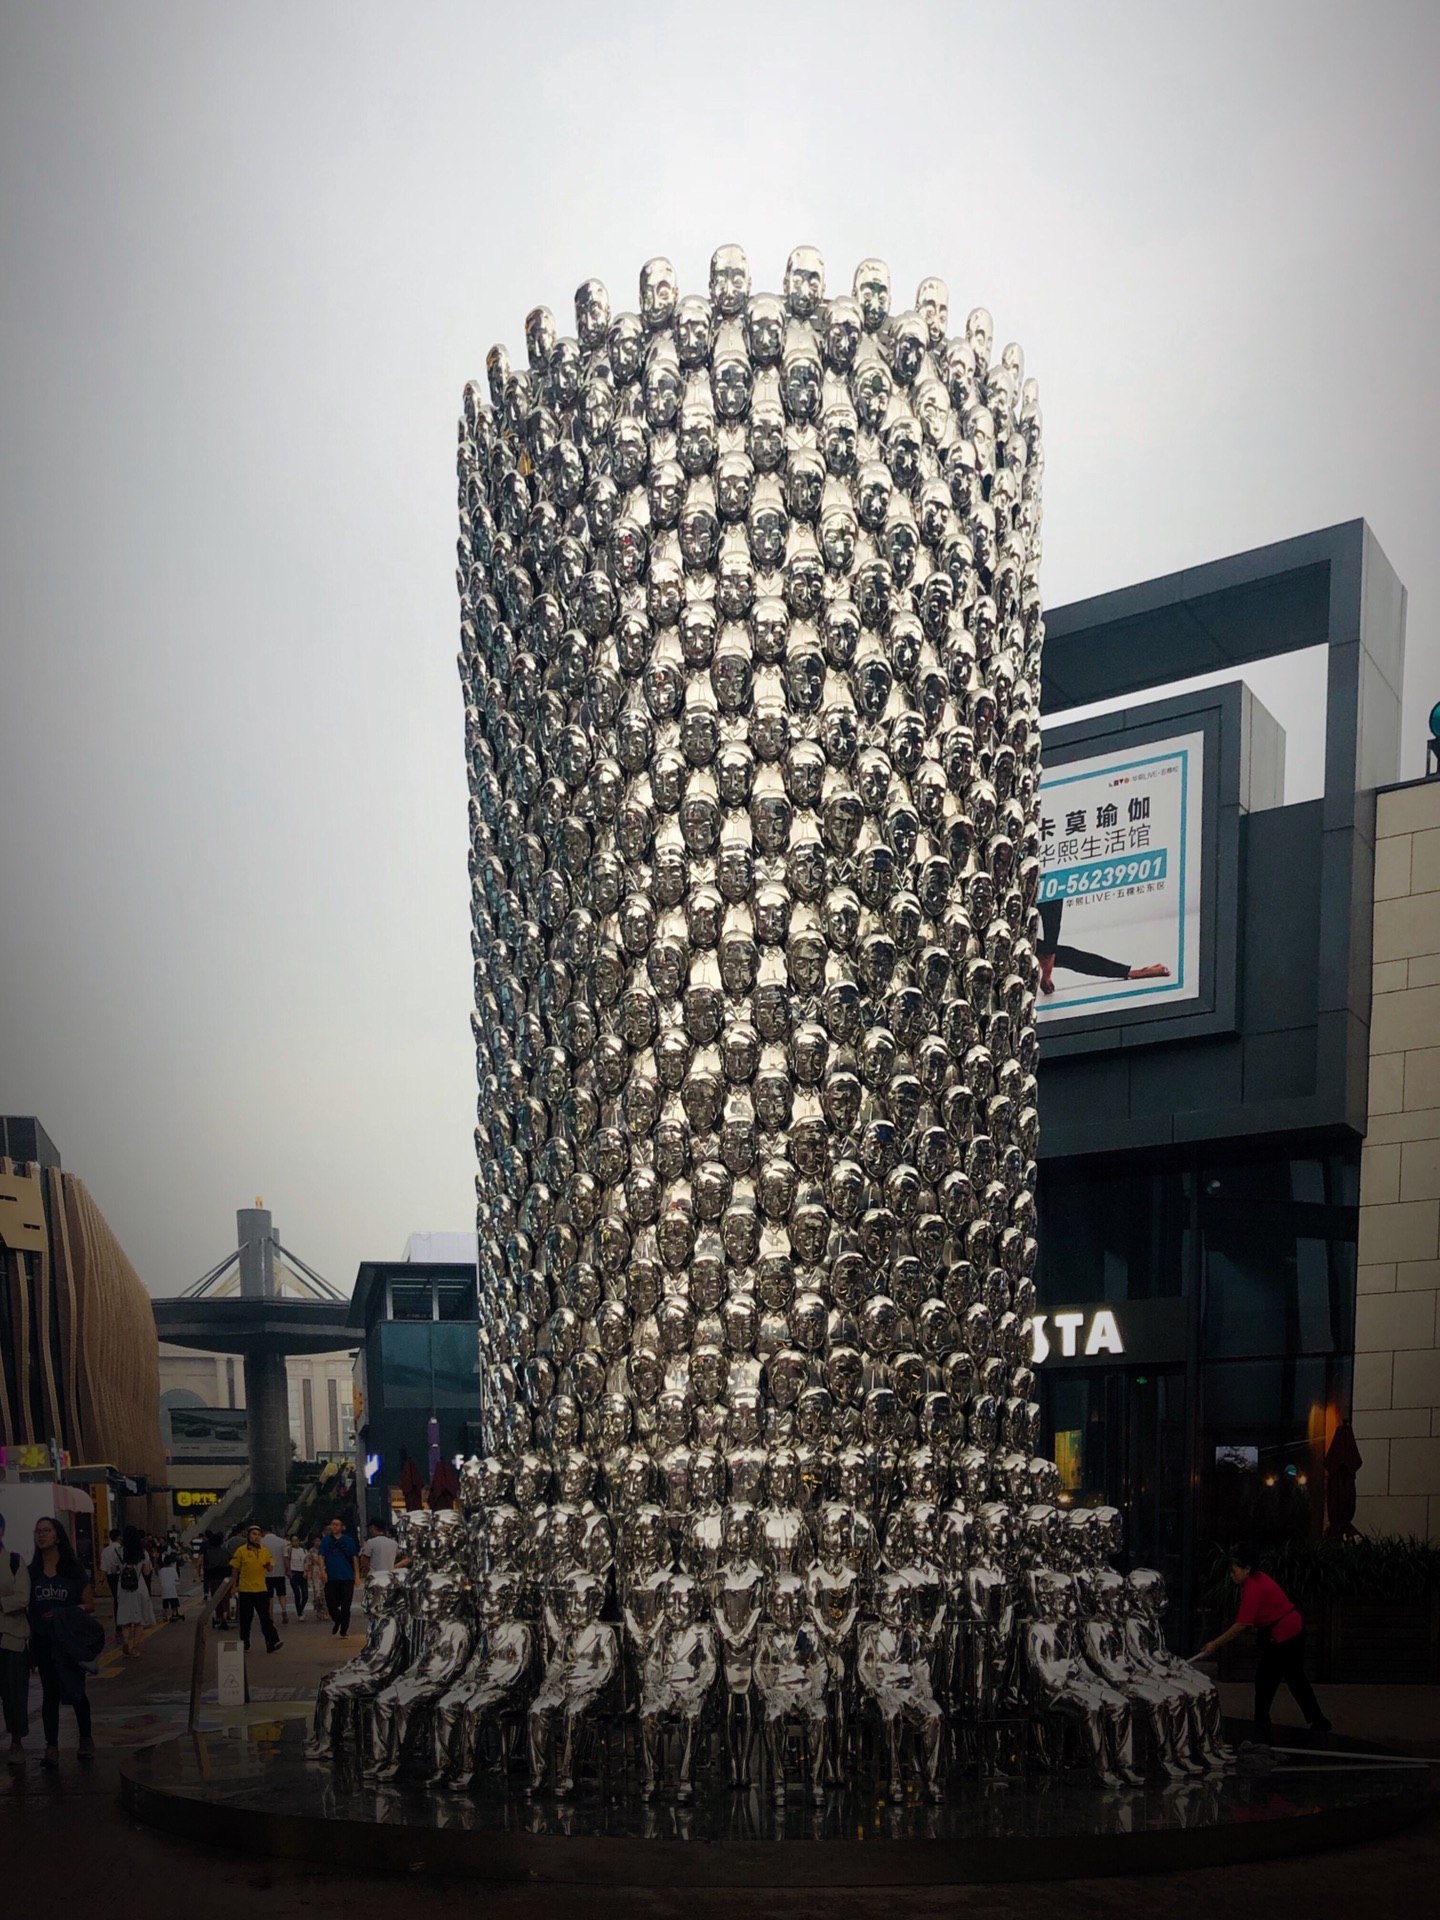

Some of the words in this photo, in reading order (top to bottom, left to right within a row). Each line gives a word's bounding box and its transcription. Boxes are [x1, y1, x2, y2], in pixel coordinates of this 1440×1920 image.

[1039, 823, 1151, 868] 华熙生活馆
[35, 1584, 69, 1599] Calvin
